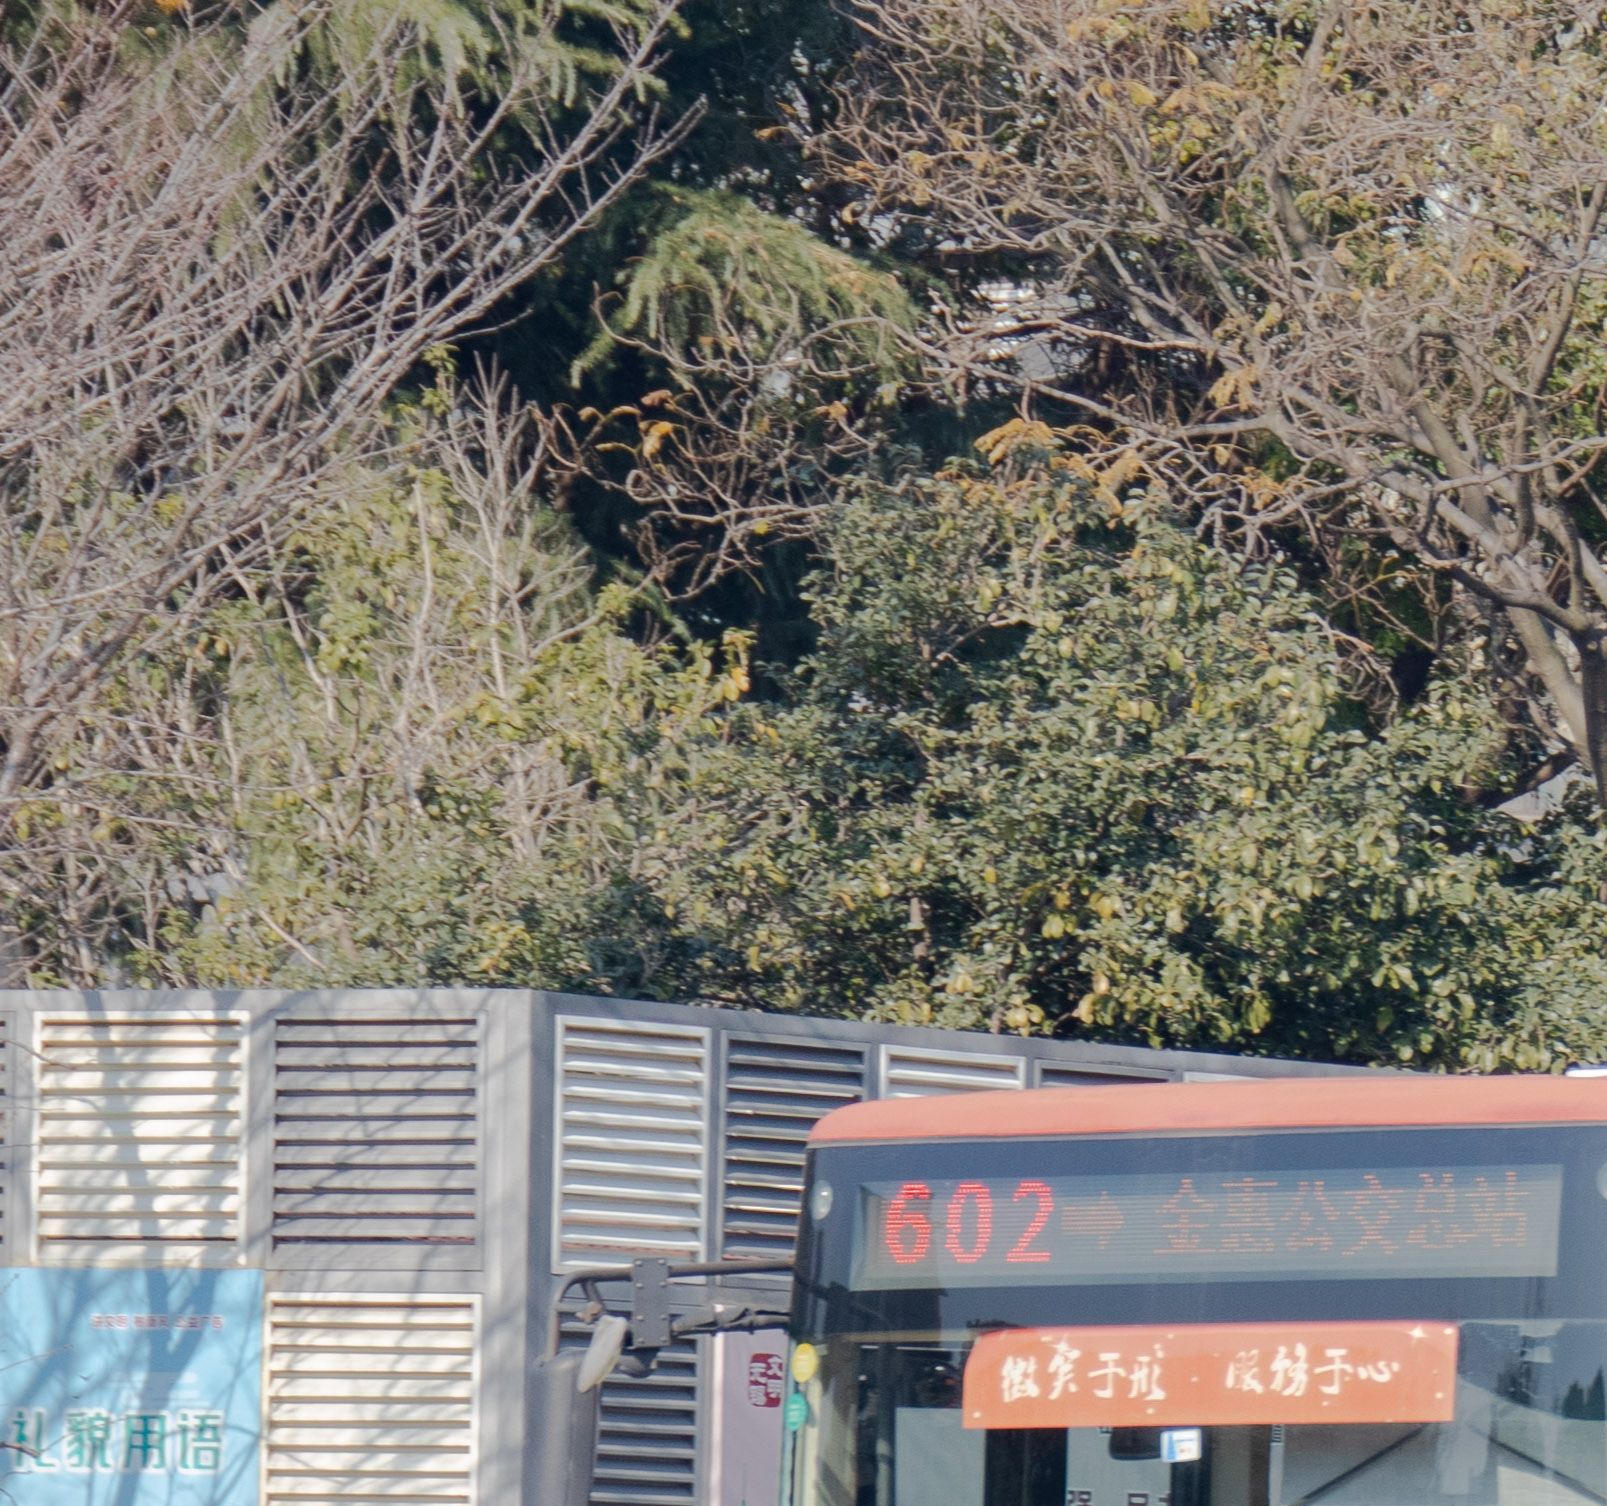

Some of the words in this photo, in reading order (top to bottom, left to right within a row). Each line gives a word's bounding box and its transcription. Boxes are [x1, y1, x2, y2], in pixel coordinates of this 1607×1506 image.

[885, 1180, 1054, 1264] 602
[11, 1408, 224, 1472] 礼貌用语
